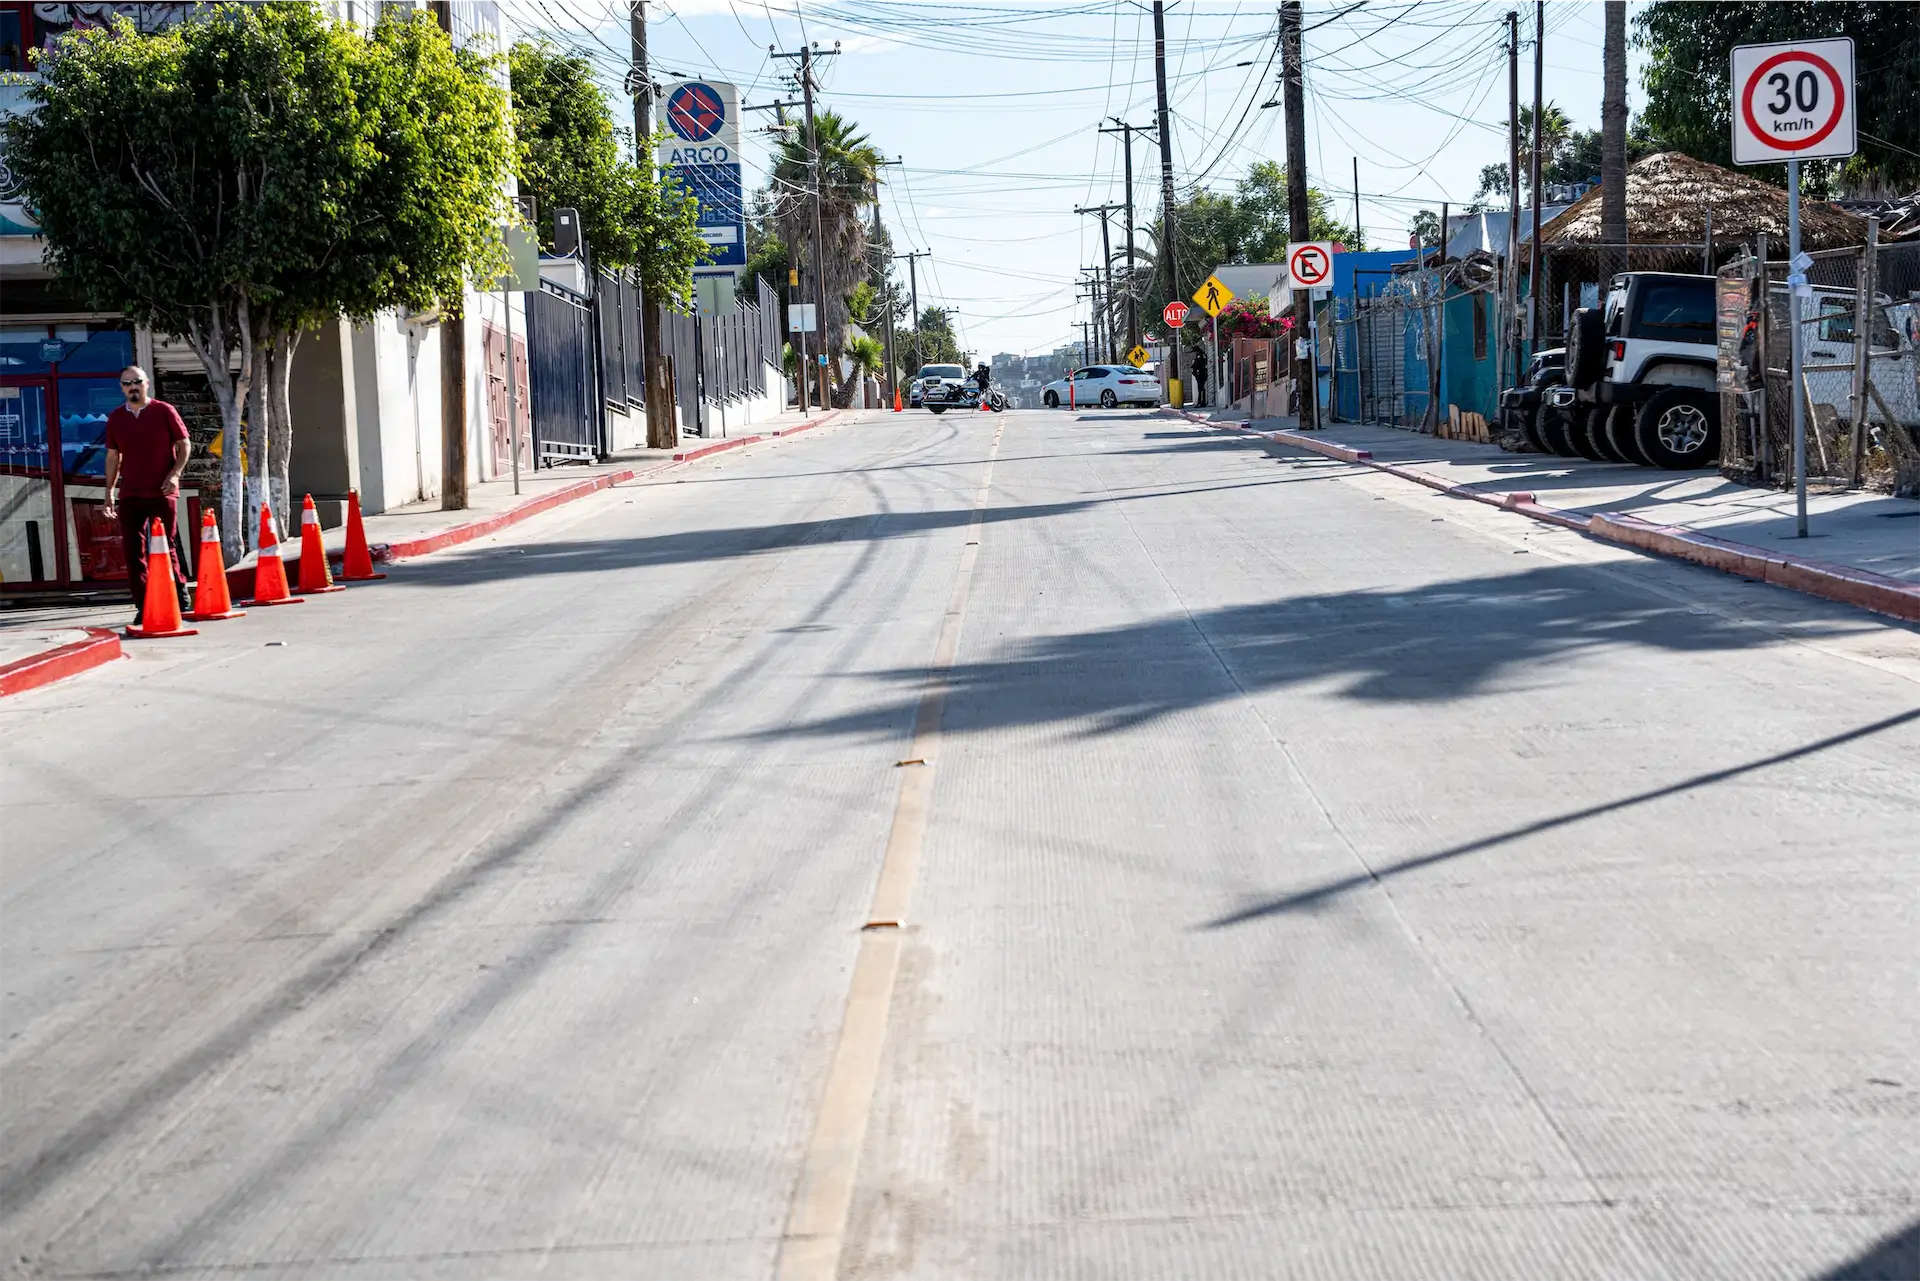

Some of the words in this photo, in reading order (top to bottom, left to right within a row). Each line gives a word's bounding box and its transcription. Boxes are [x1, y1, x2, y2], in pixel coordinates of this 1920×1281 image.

[1768, 70, 1818, 115] 30
[1774, 118, 1813, 132] km/h
[670, 147, 728, 164] ARCO
[1300, 253, 1319, 277] E
